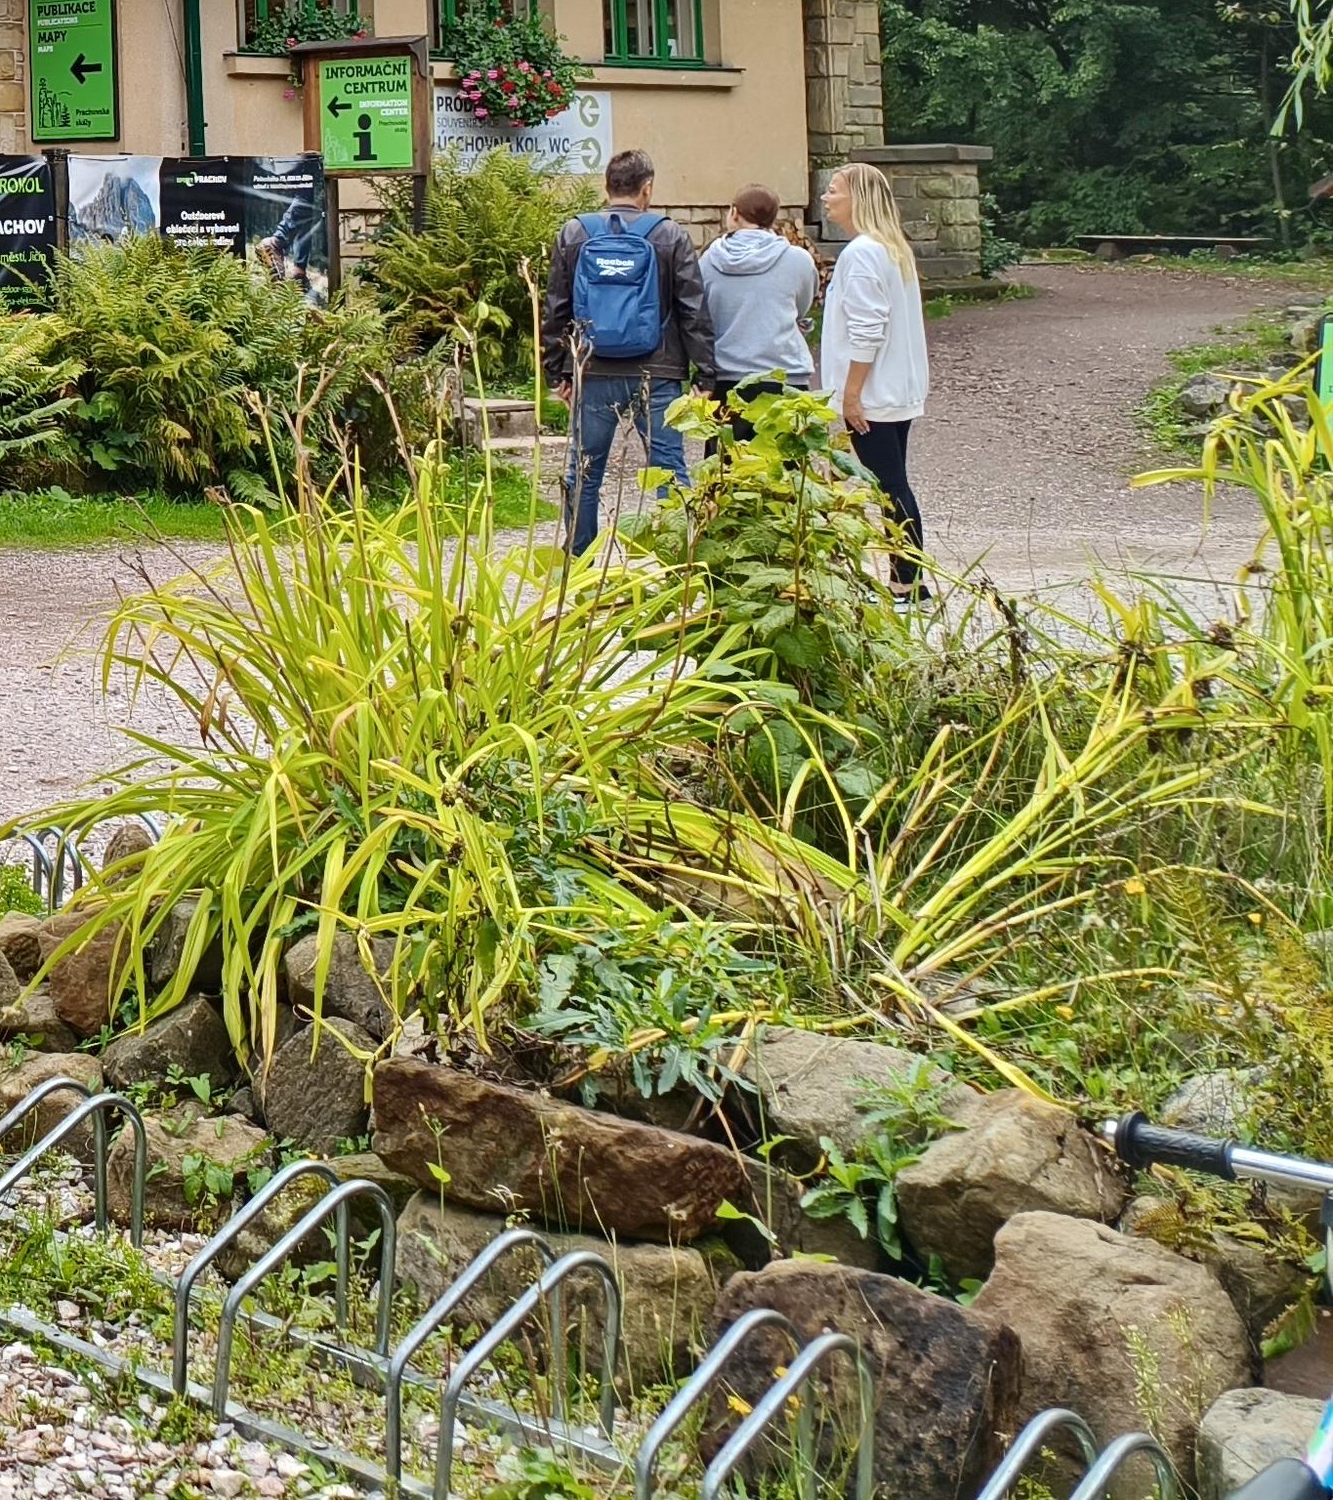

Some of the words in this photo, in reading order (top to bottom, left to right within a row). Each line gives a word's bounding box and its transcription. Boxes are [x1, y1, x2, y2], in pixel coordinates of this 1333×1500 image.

[37, 1, 96, 17] PUBLIKACE
[38, 30, 67, 44] MAPY
[37, 45, 53, 53] MAPS
[325, 60, 407, 79] INFORMAČNÍ
[344, 80, 407, 94] CENTRUM
[359, 100, 408, 108] INFORMATION
[381, 108, 408, 116] CENTER
[549, 137, 572, 153] WC
[596, 257, 635, 266] Reebok
